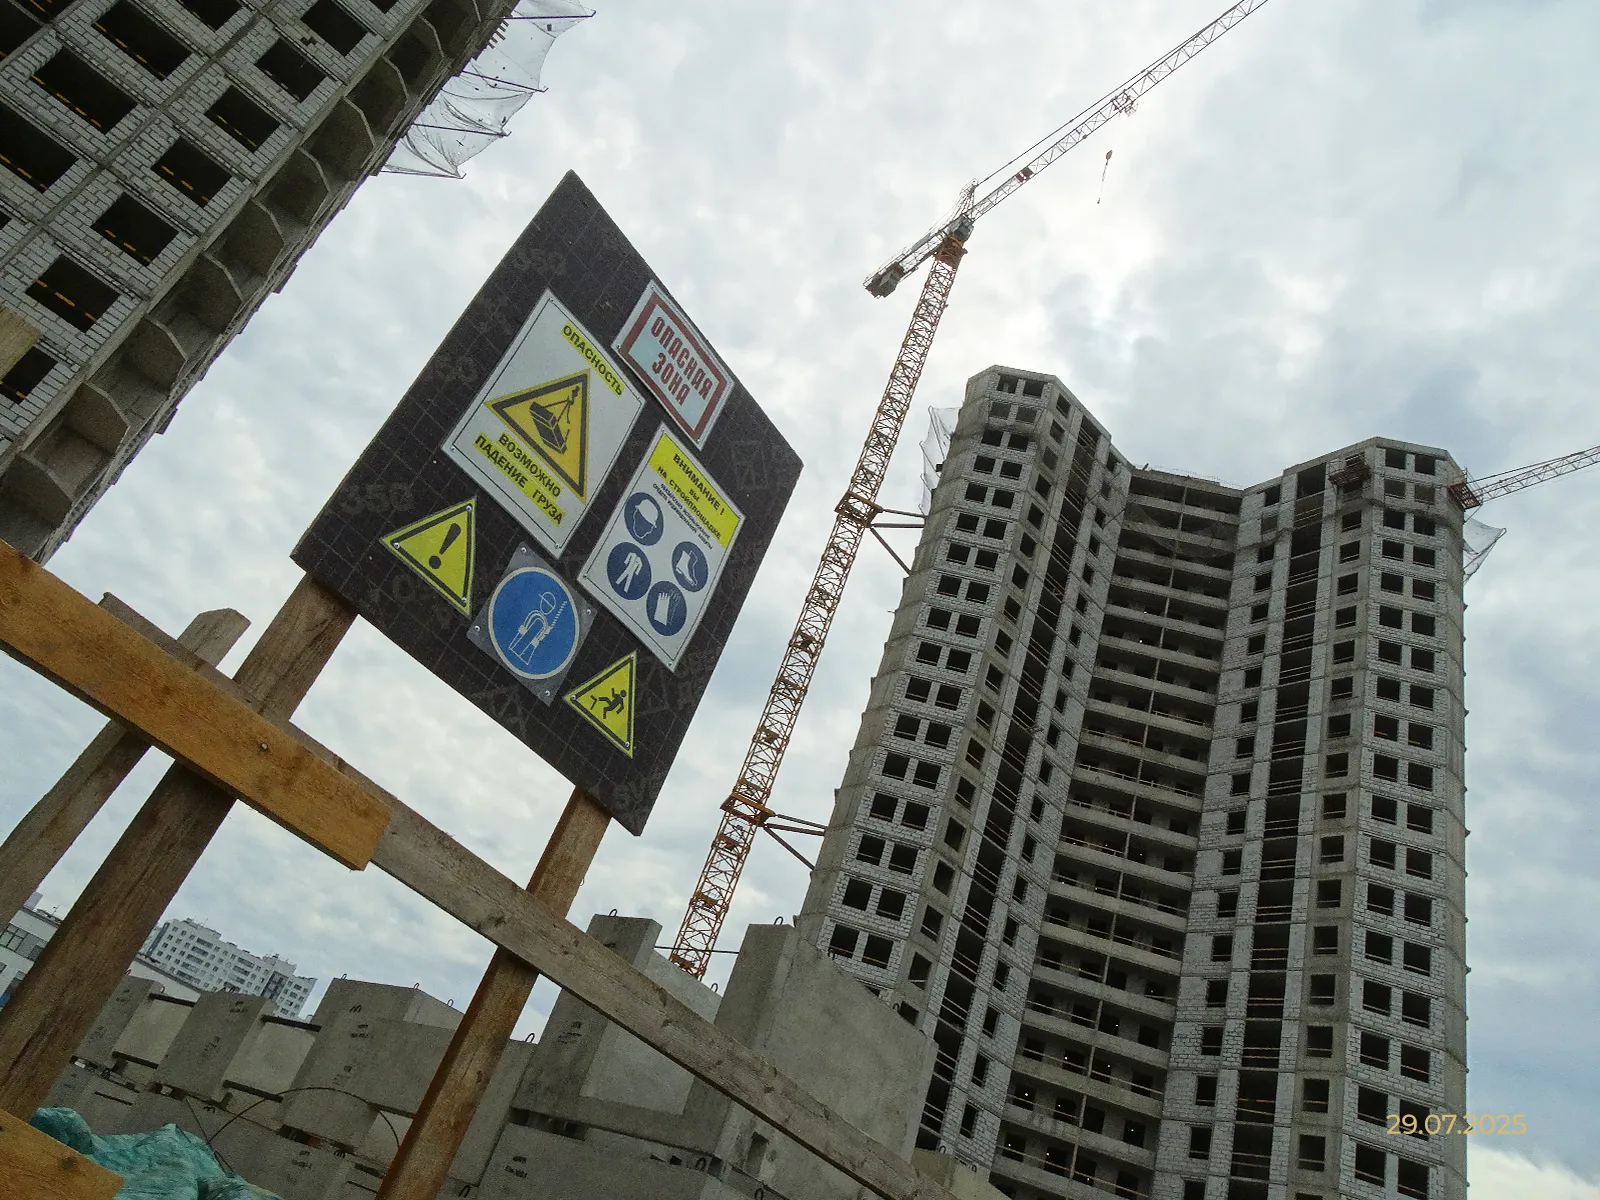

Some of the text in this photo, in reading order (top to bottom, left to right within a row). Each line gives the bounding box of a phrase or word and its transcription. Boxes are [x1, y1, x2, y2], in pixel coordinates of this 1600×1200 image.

[563, 324, 622, 396] ОПАСНОСТЬ
[651, 316, 713, 399] ОПАСНАЯ
[652, 352, 690, 406] ЗОНА
[475, 434, 563, 525] ПАДЕНИЕ ГРУЗА
[498, 432, 561, 497] ВОЗМОЖНО
[673, 453, 720, 511] ВНИМАНИЕ
[657, 466, 667, 479] НА
[669, 479, 721, 540] СТРОЙПЛОЩАДКЕ
